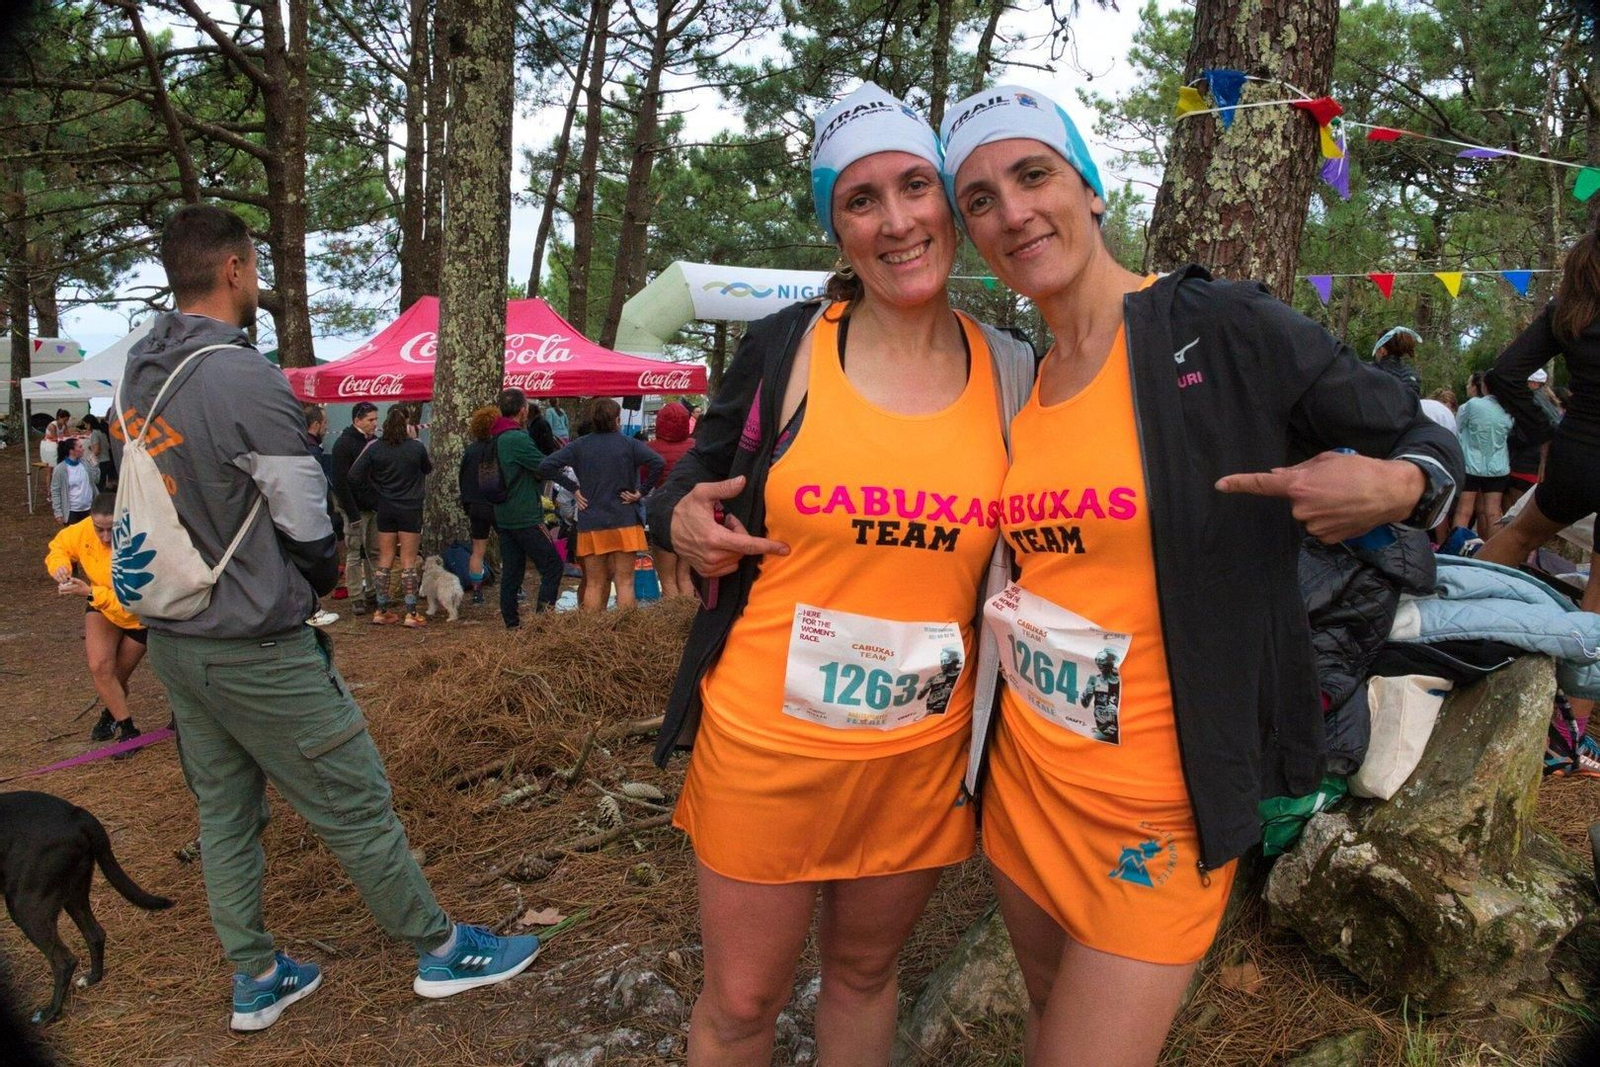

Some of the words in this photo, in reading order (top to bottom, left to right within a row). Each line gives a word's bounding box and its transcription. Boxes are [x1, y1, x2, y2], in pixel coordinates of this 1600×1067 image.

[503, 370, 556, 391] oca-Cola
[794, 485, 999, 530] CABUXAS
[852, 519, 960, 552] TEAM
[1010, 526, 1086, 554] TEAM
[802, 617, 817, 626] FOR
[817, 620, 832, 629] THE
[803, 609, 821, 618] HERE
[800, 625, 836, 638] WOMEN'S
[1016, 618, 1048, 639] CABUXAS
[1022, 628, 1042, 643] TEAM
[851, 643, 895, 657] CABUXAS
[859, 651, 887, 662] TEAM
[1007, 633, 1079, 705] 1264
[819, 661, 920, 711] 1263
